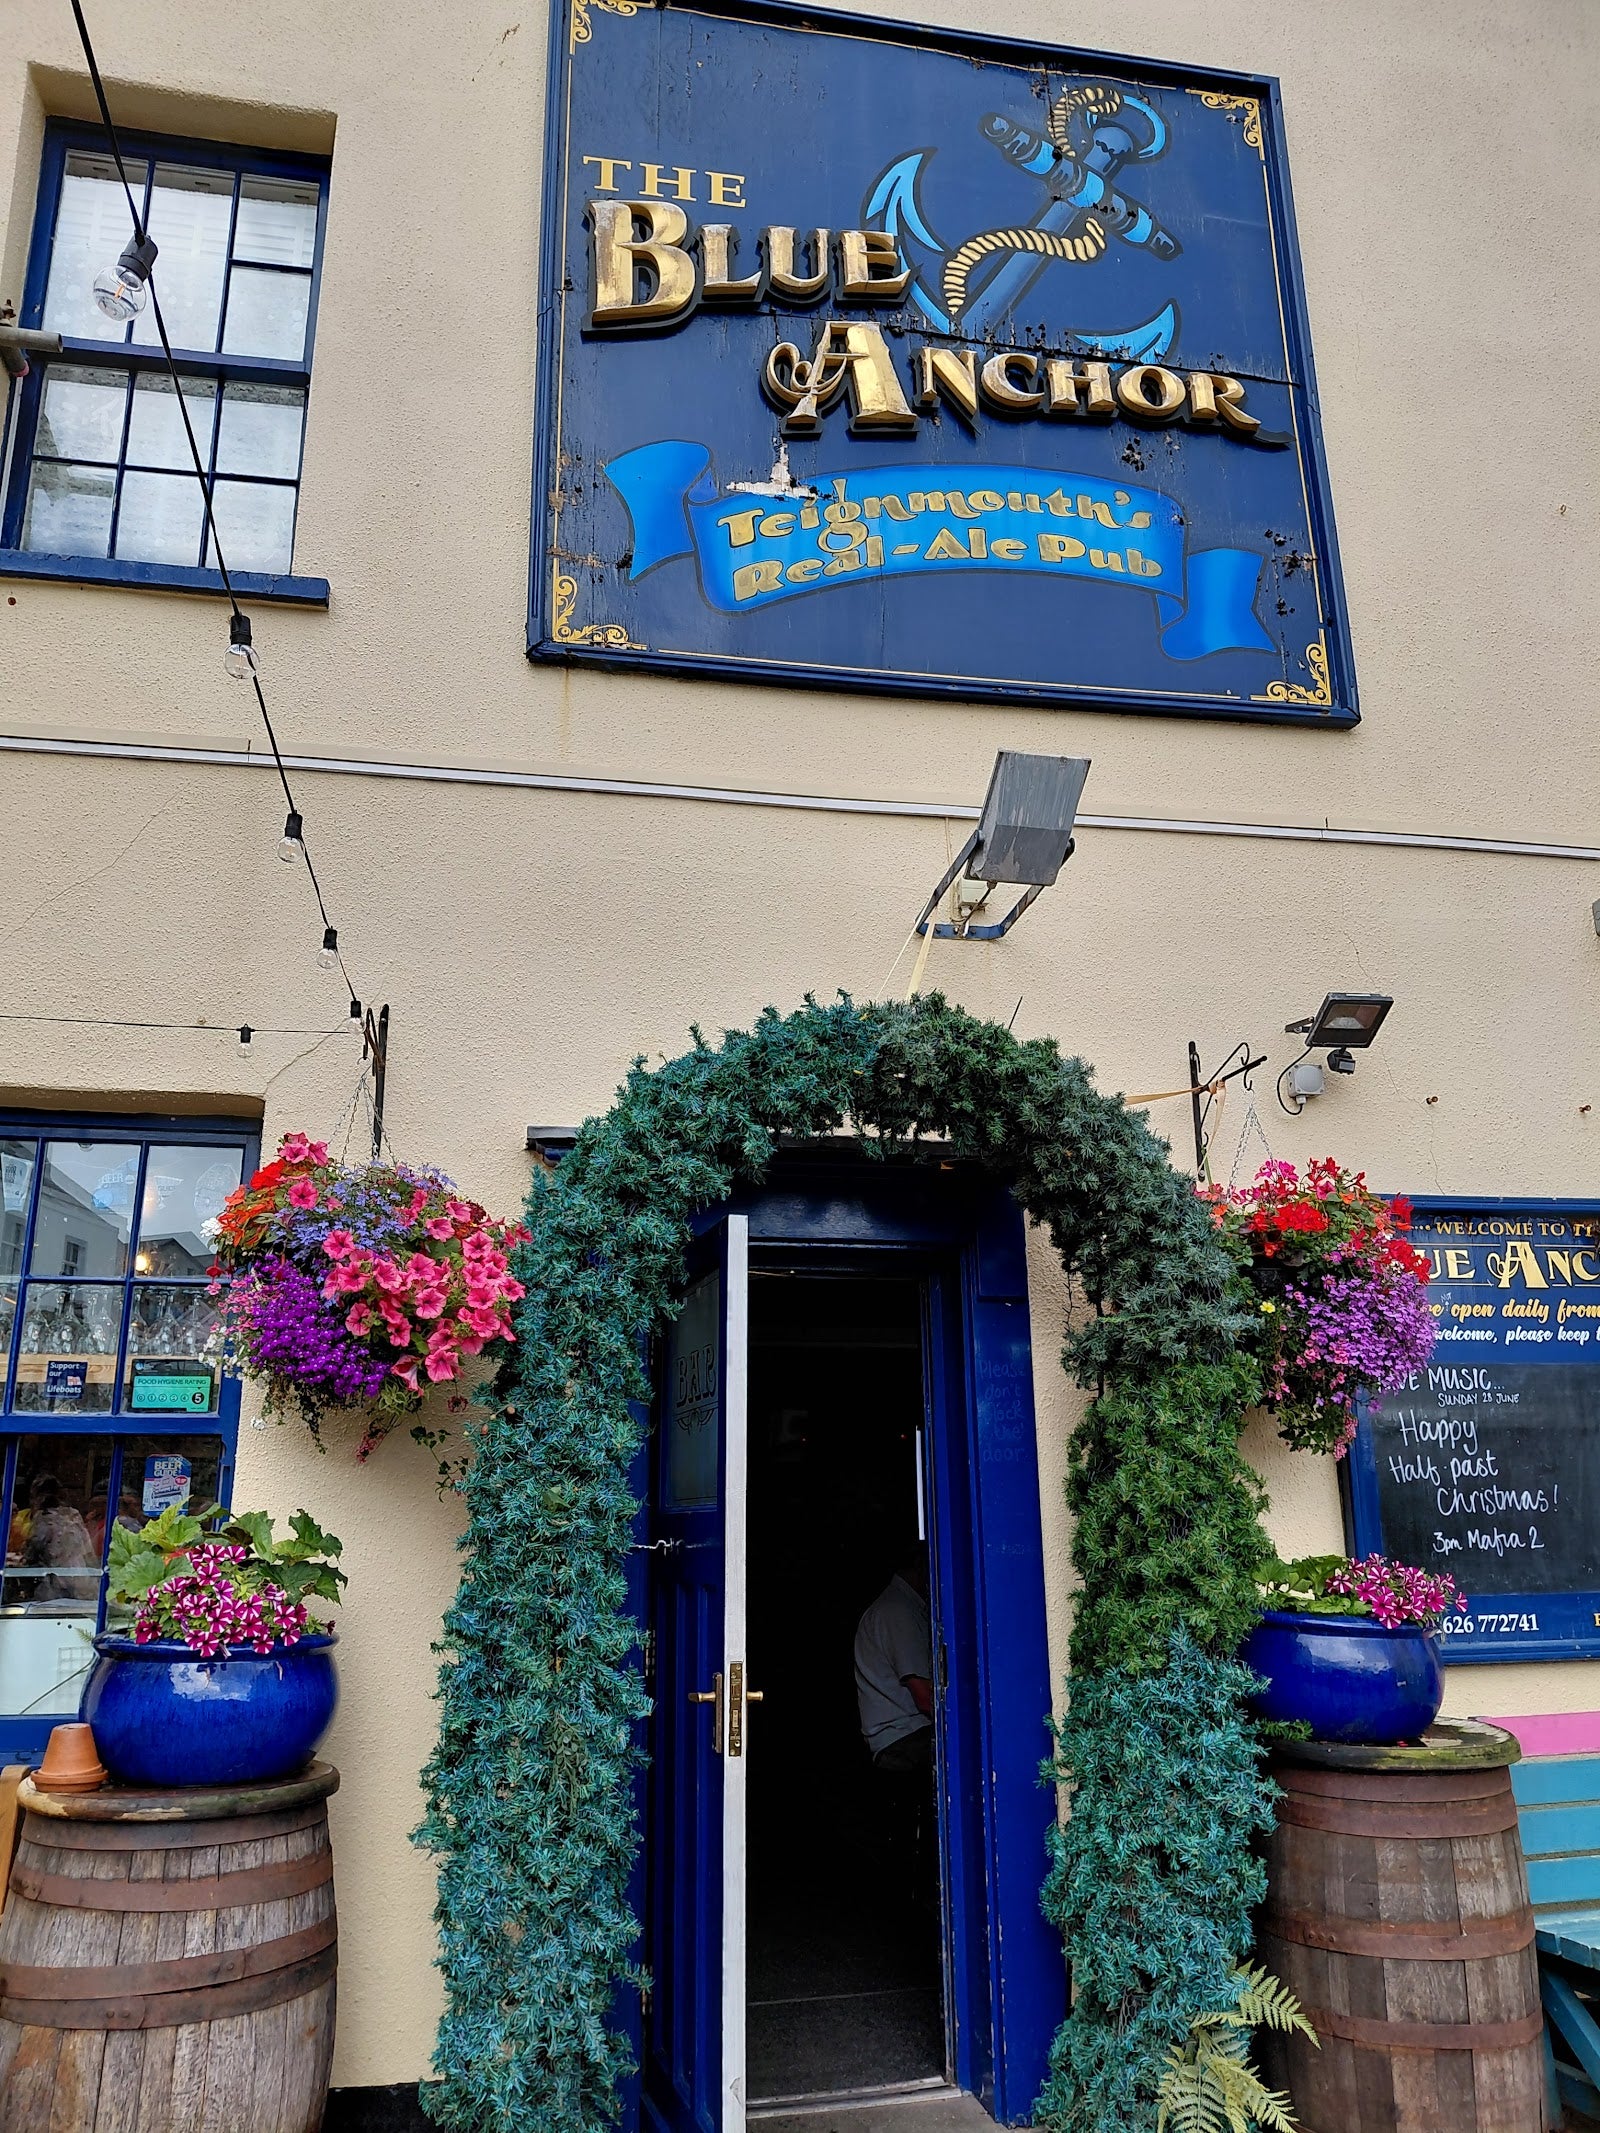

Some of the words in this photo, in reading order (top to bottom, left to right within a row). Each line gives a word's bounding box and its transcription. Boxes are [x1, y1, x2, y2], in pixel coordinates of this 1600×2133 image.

[583, 156, 747, 208] THE
[586, 200, 913, 328] BLUE
[766, 321, 1264, 435] ANCHOR
[718, 478, 1152, 555] Teignmouth's
[1037, 533, 1162, 577] Pub
[1436, 1221, 1533, 1236] WELCOME
[1538, 1222, 1565, 1236] TO
[1413, 1249, 1475, 1279] UE
[1487, 1241, 1600, 1288] ANC
[1451, 1303, 1496, 1323] open
[1502, 1298, 1549, 1323] daily
[1505, 1325, 1553, 1345] please
[1557, 1325, 1590, 1346] keep
[50, 1362, 80, 1370] Support
[676, 1343, 717, 1408] BAR
[47, 1385, 81, 1394] Lifeboats
[195, 1393, 202, 1404] 5
[1438, 1392, 1478, 1408] SUNDAY
[1482, 1392, 1493, 1402] 28
[1496, 1393, 1520, 1404] JUNE
[1399, 1409, 1478, 1455] Happy
[154, 1460, 182, 1470] BEER
[1432, 1531, 1462, 1555] 3pm
[1467, 1526, 1525, 1557] Mafia
[1528, 1525, 1544, 1549] 2
[1477, 1613, 1540, 1633] 772741
